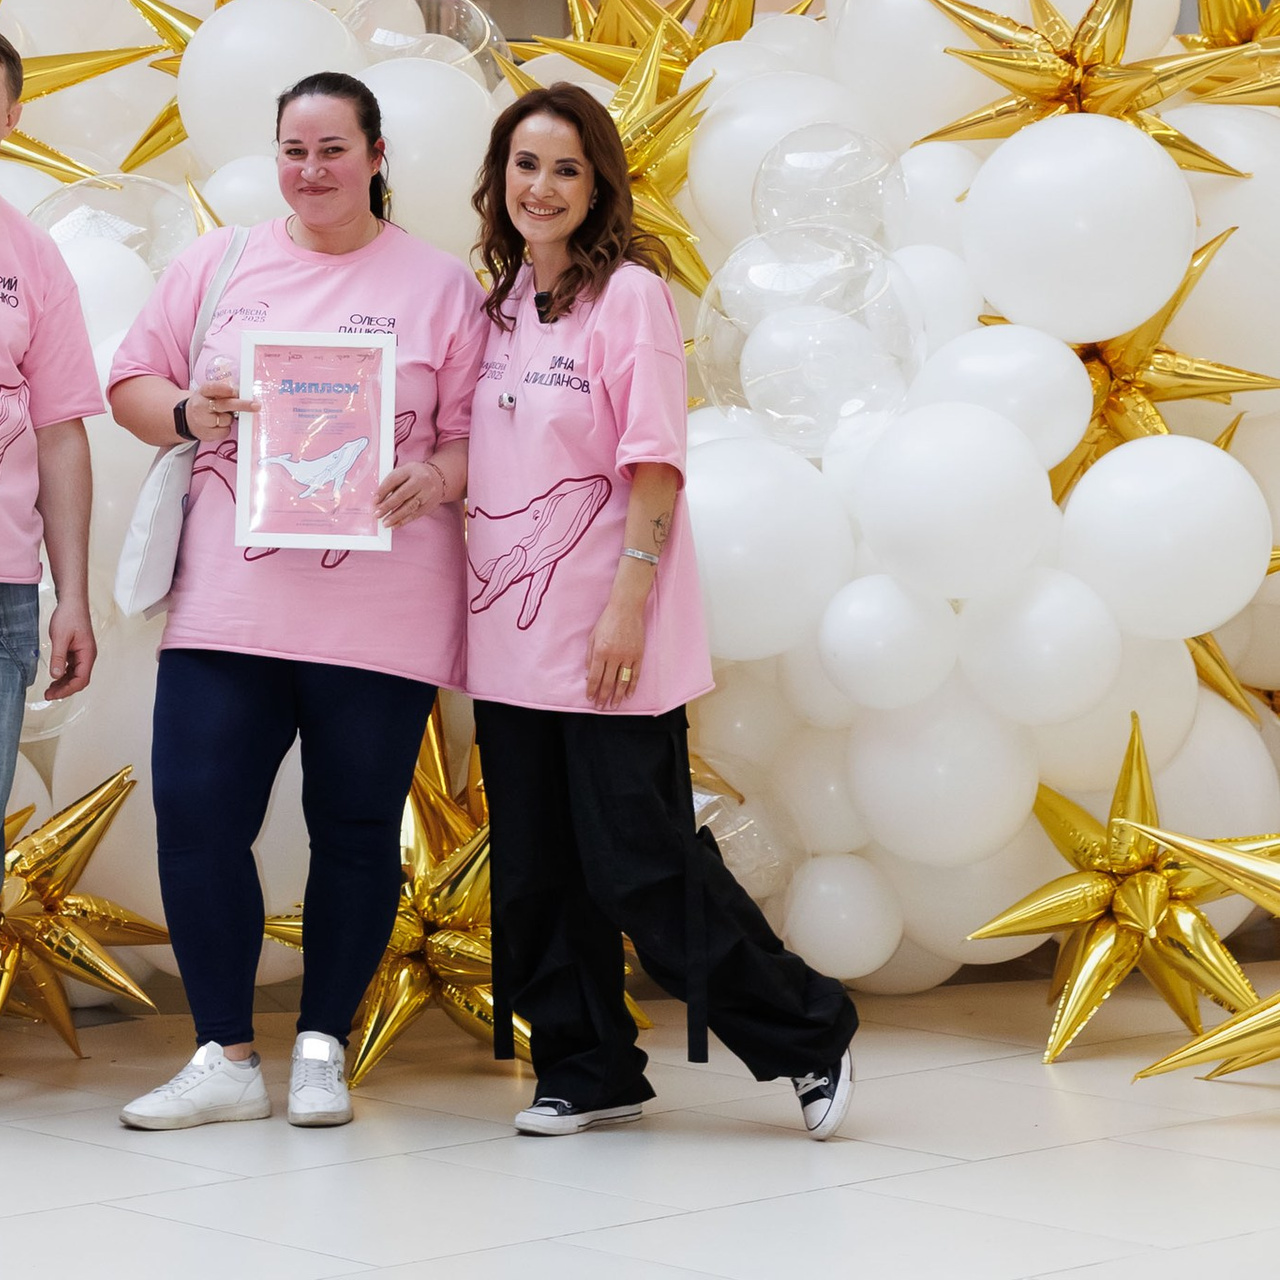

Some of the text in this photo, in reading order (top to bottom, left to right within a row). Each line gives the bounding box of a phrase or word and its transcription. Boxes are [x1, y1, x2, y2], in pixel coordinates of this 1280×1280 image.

[242, 315, 266, 323] 2025
[349, 313, 396, 329] ОЛЕСЯ
[278, 379, 360, 396] Диплом
